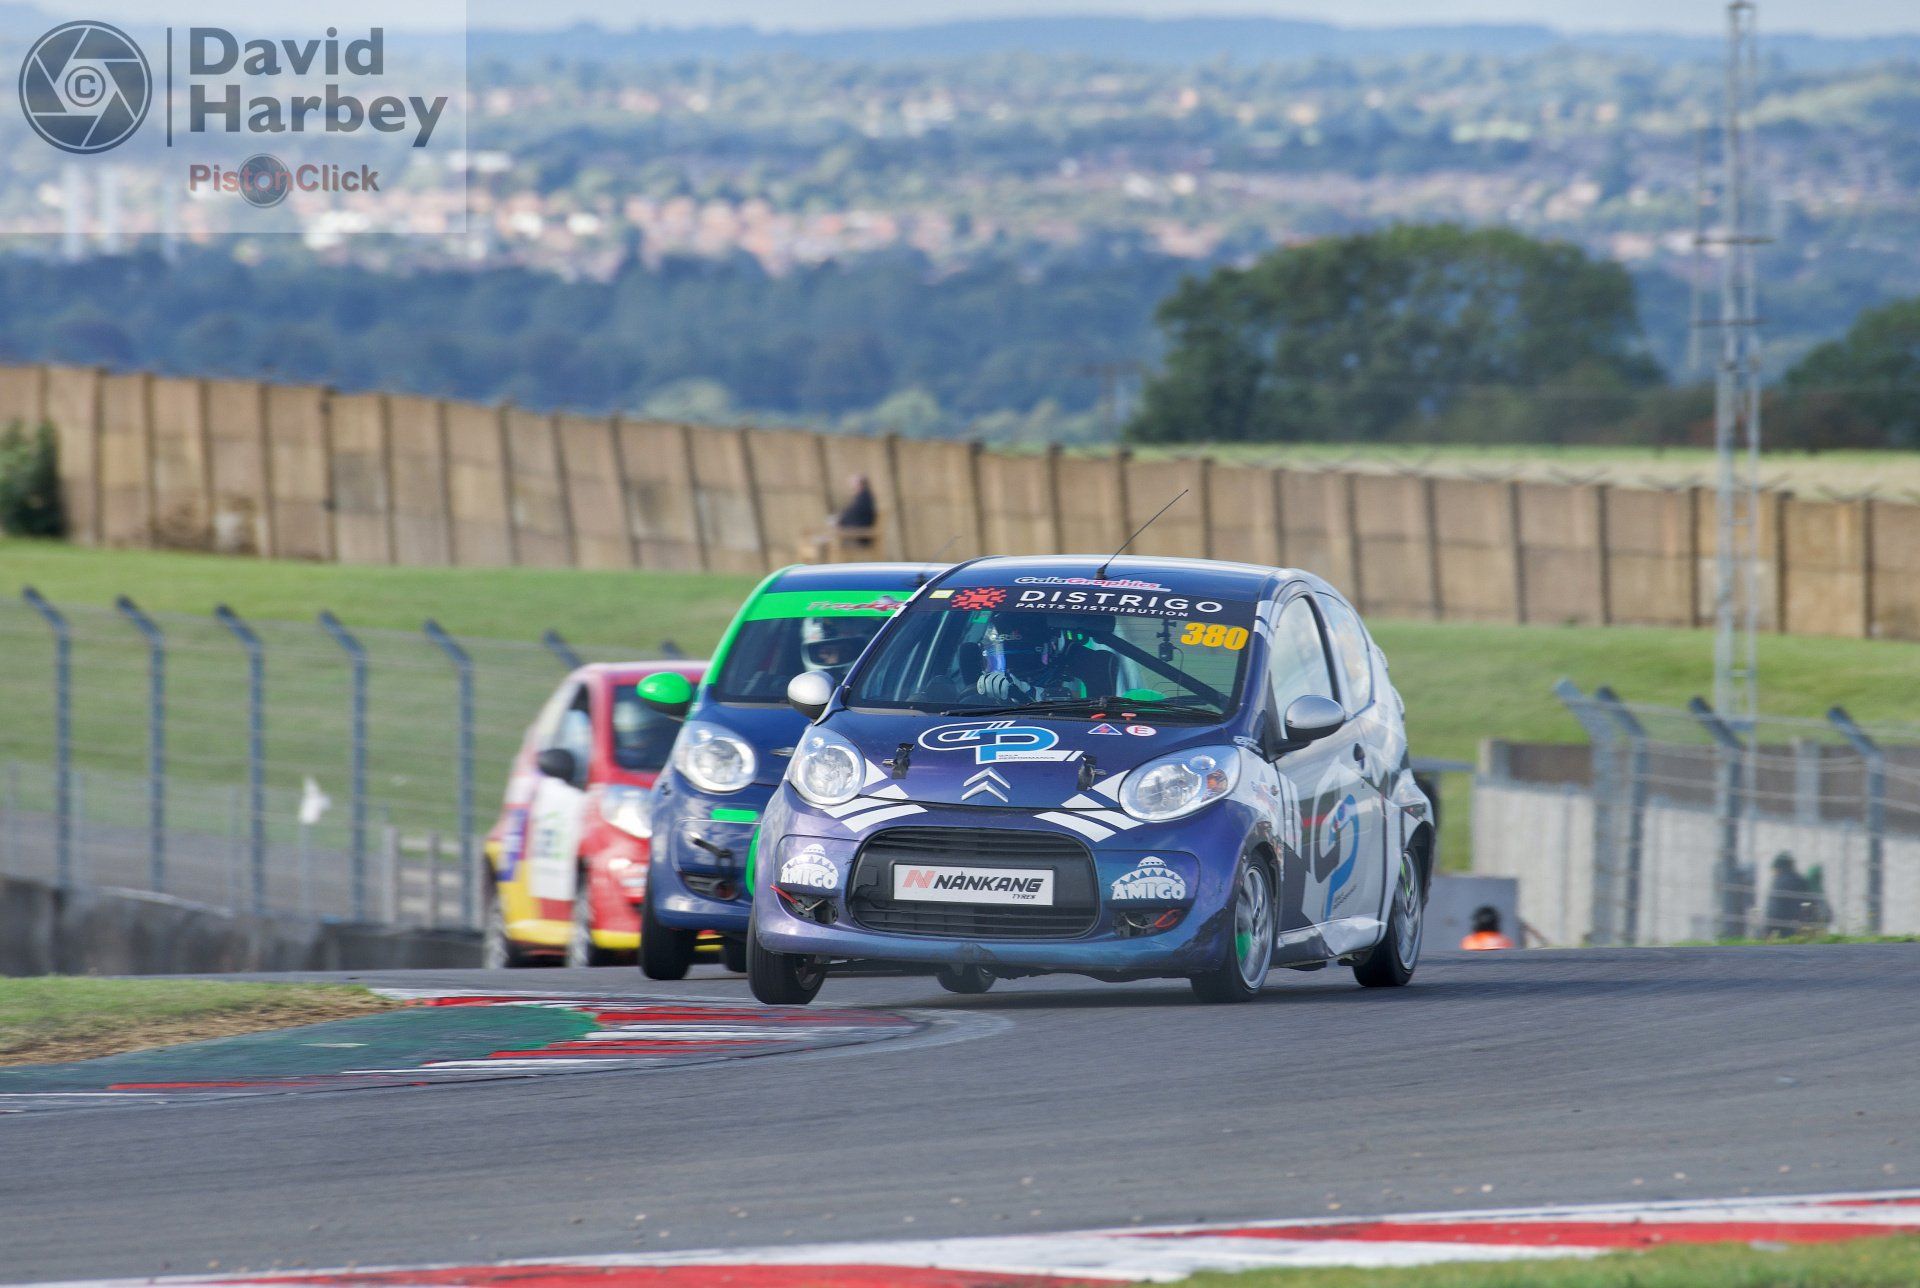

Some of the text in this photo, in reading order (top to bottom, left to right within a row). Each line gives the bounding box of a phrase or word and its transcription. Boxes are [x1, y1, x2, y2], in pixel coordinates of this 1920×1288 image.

[1019, 590, 1223, 613] DISTRIGO
[1071, 604, 1189, 617] DISTRIBUTION
[1181, 622, 1249, 651] 380
[781, 867, 838, 890] AMIGO
[1111, 882, 1186, 900] AMIGO
